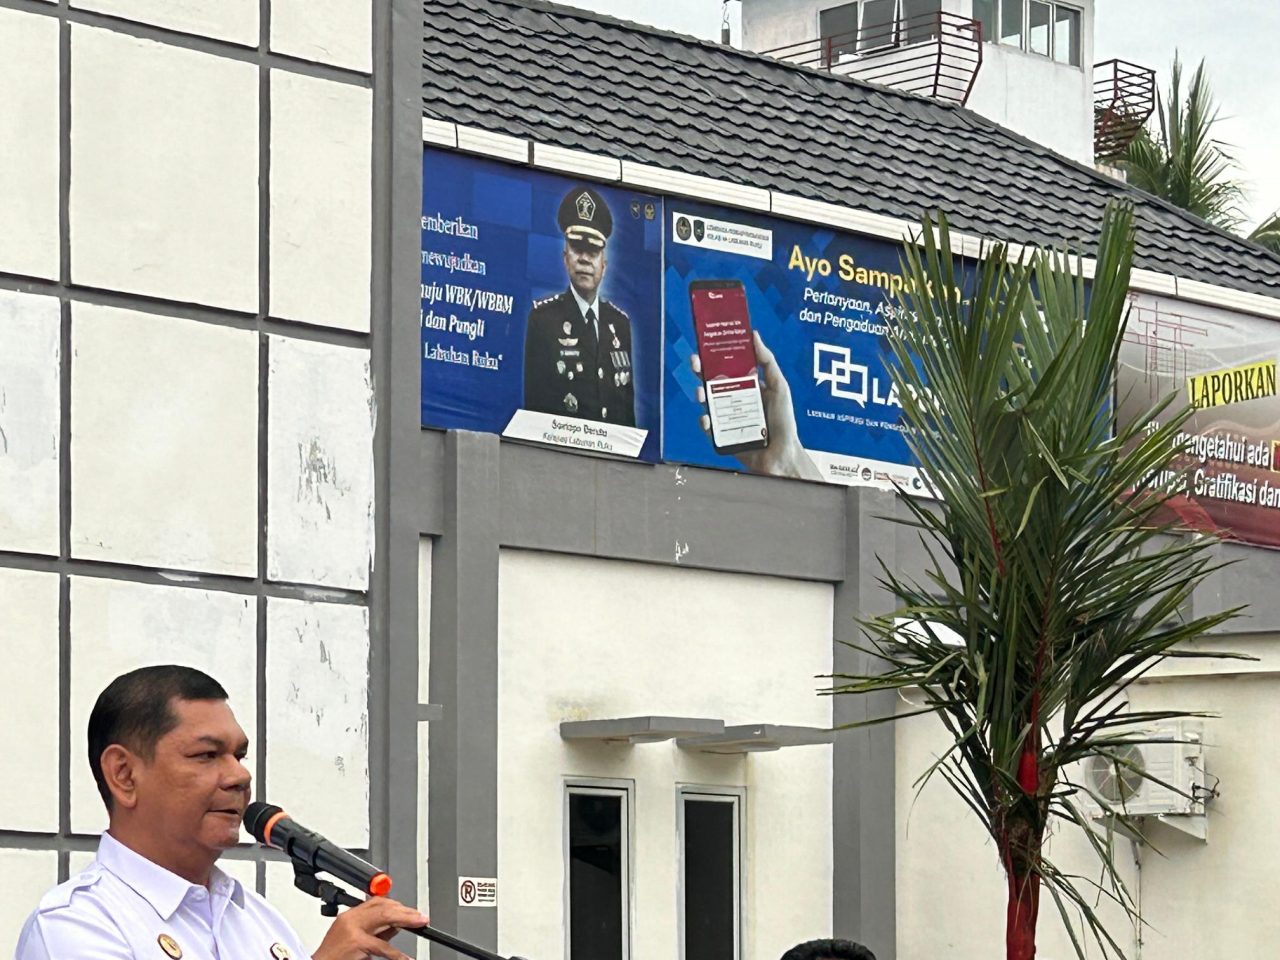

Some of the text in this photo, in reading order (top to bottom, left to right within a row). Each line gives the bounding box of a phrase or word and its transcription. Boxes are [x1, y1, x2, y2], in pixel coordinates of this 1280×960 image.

[788, 244, 832, 282] Ayo
[445, 283, 514, 315] WBK/WBBM
[425, 310, 447, 331] dan
[449, 314, 485, 341] Pungli
[799, 308, 822, 322] dan
[824, 313, 890, 336] Pengaduan
[1191, 364, 1277, 409] LAPORKAN
[1247, 440, 1269, 466] ada
[1194, 468, 1257, 503] Gratifikasi
